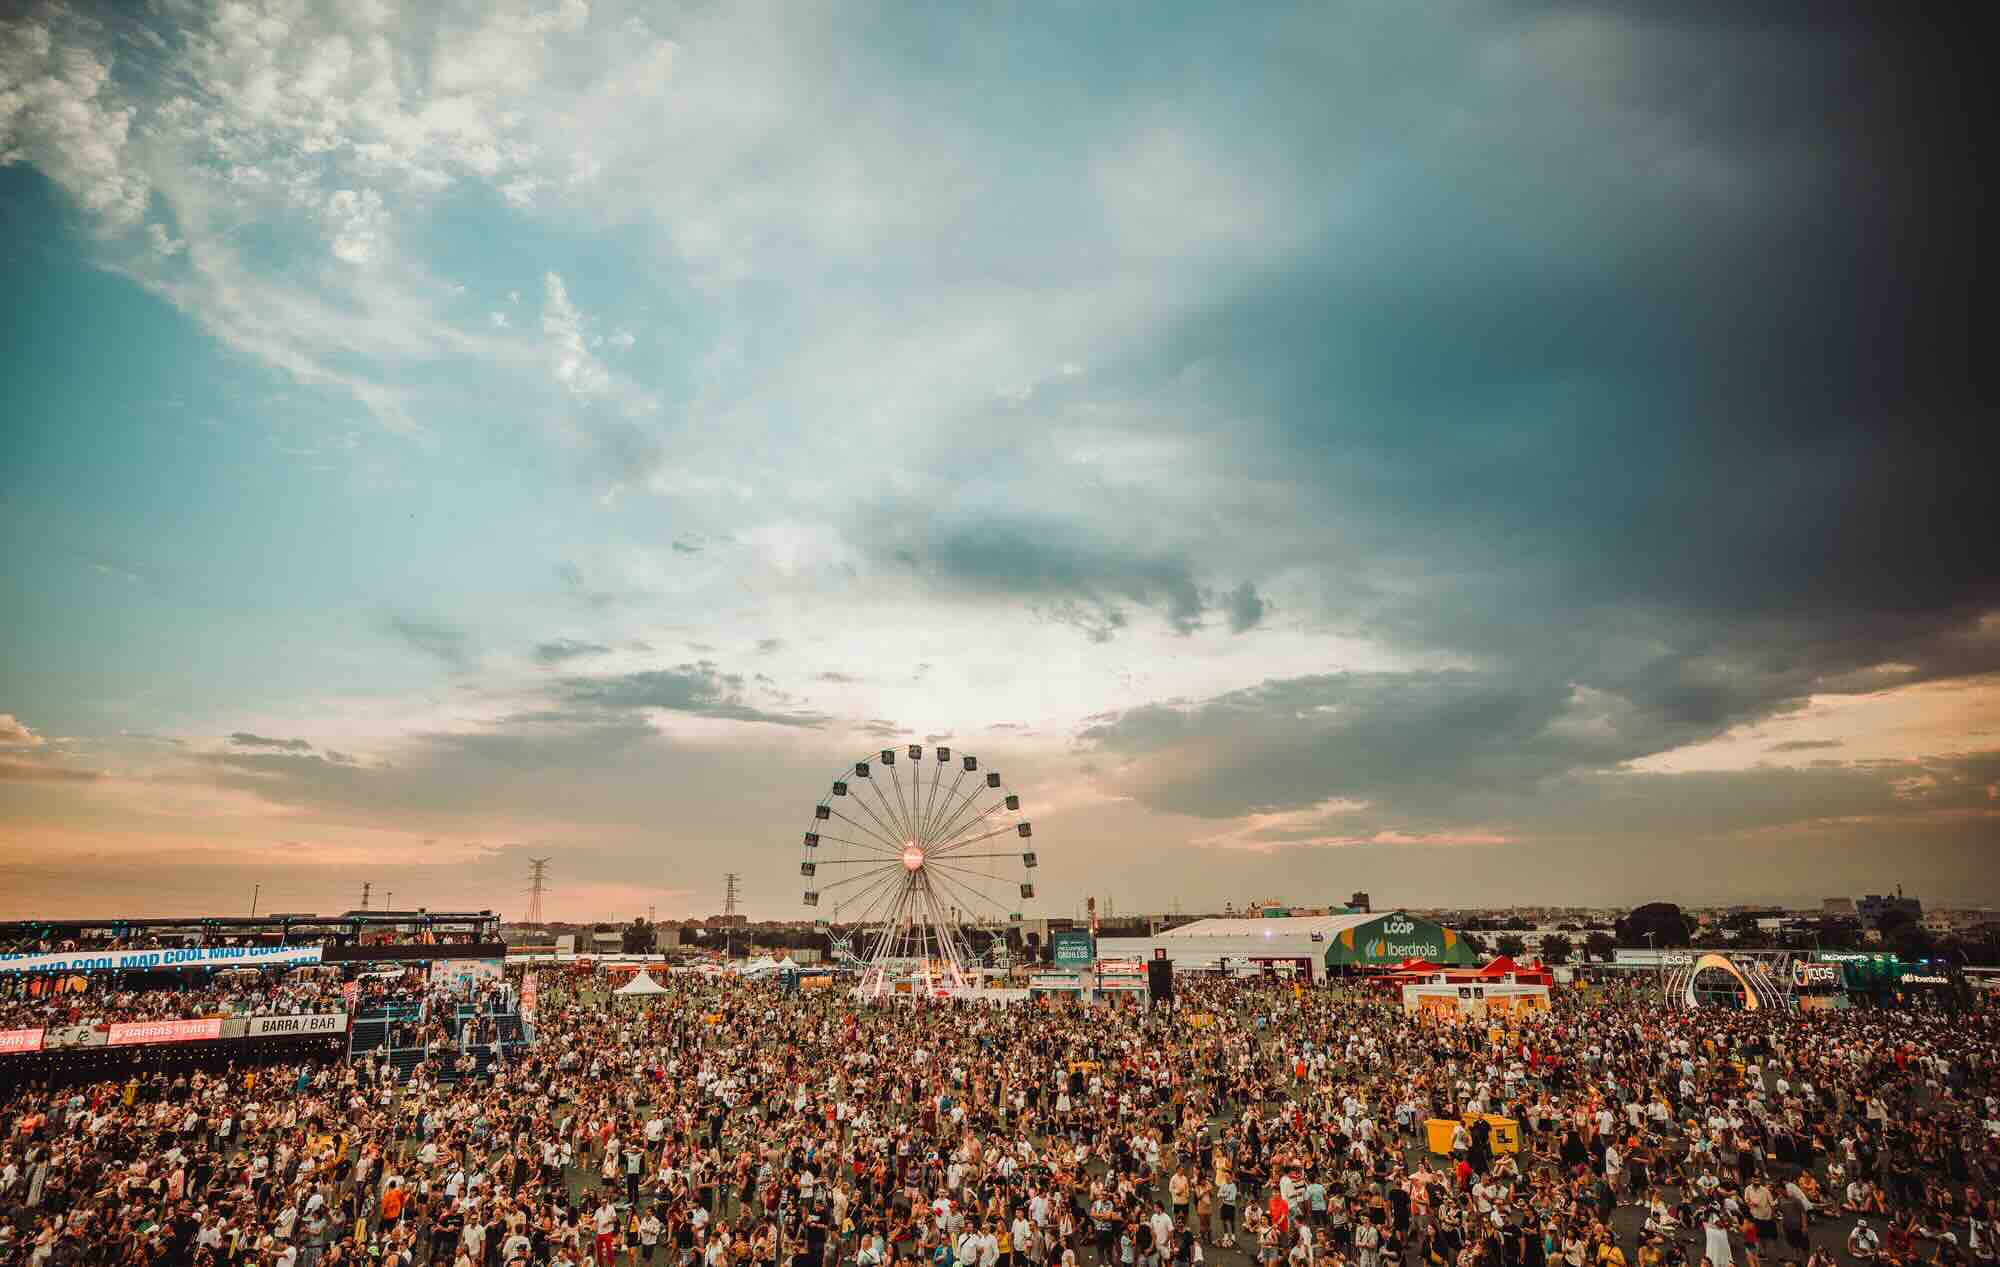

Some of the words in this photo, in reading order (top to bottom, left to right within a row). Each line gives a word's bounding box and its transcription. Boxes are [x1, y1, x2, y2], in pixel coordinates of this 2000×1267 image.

[1383, 922, 1414, 934] LOOP
[1387, 941, 1438, 956] Iberdrola
[121, 953, 160, 968] MAD
[163, 951, 205, 964] COOL
[207, 947, 245, 960] MAD
[1808, 967, 1834, 982] IQOS
[262, 1019, 299, 1032] BARRA
[310, 1017, 336, 1030] BAR
